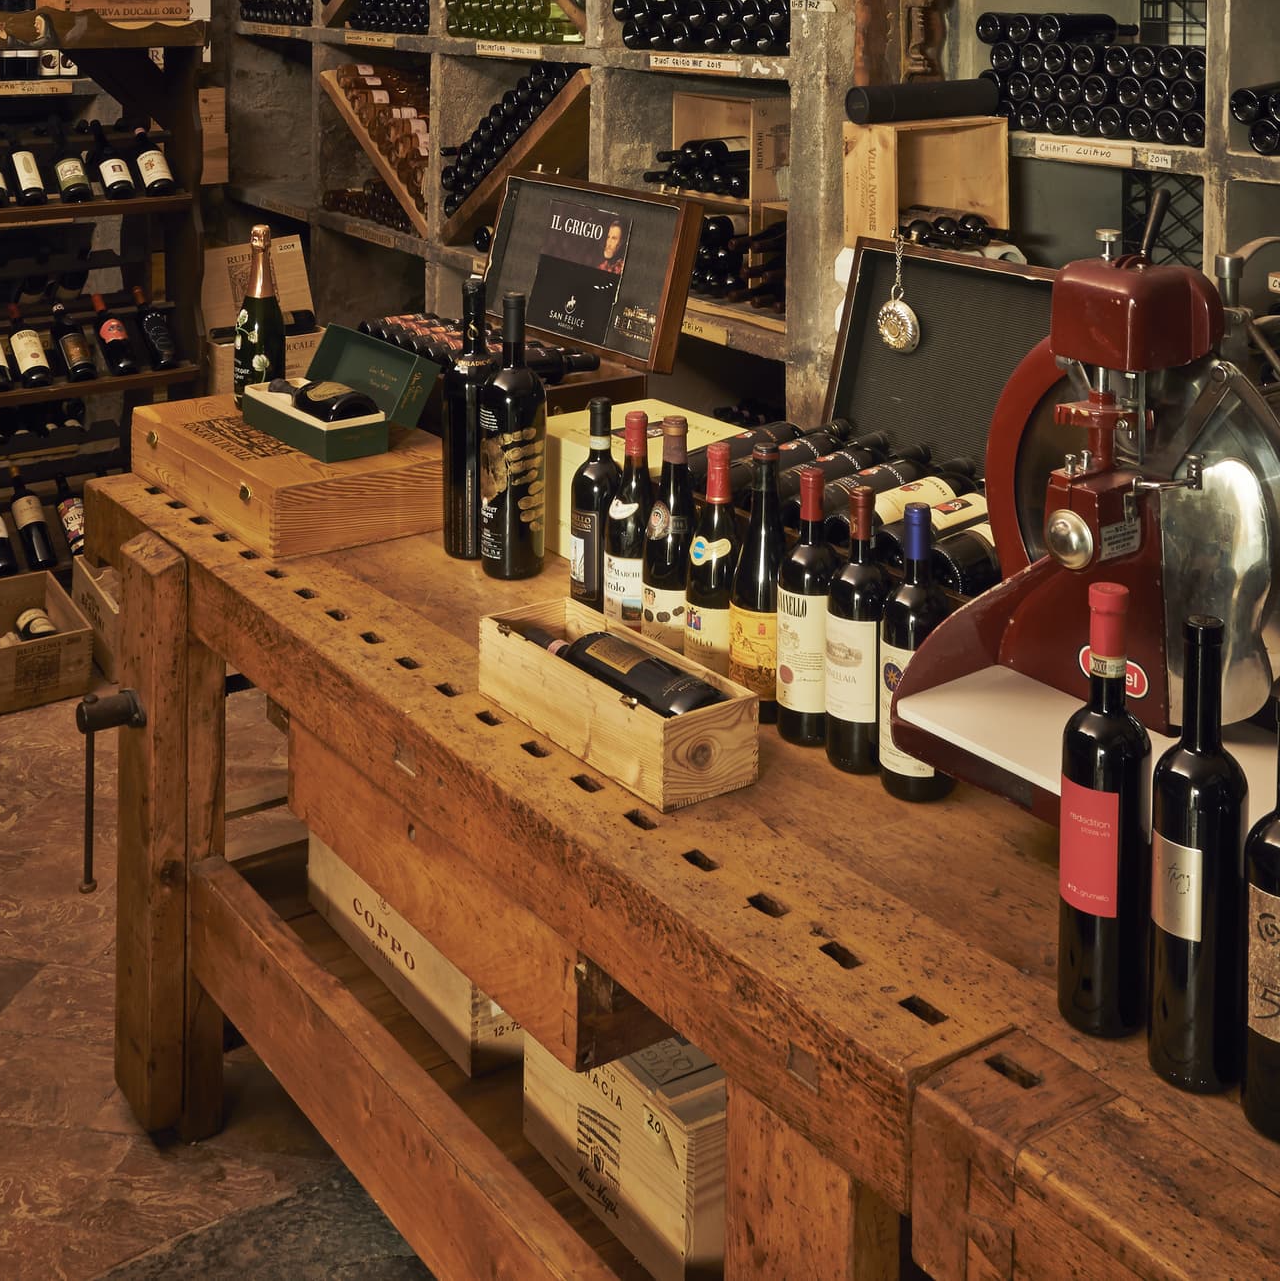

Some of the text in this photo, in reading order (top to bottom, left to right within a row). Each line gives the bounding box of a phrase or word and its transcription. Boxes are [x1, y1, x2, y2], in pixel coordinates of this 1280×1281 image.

[123, 6, 160, 16] DUCALE
[161, 6, 182, 15] ORO
[868, 147, 878, 233] VILLA NOVARE
[551, 214, 604, 240] IL GRIGIO
[549, 310, 585, 328] SAN FELICE
[352, 897, 417, 971] COPPO
